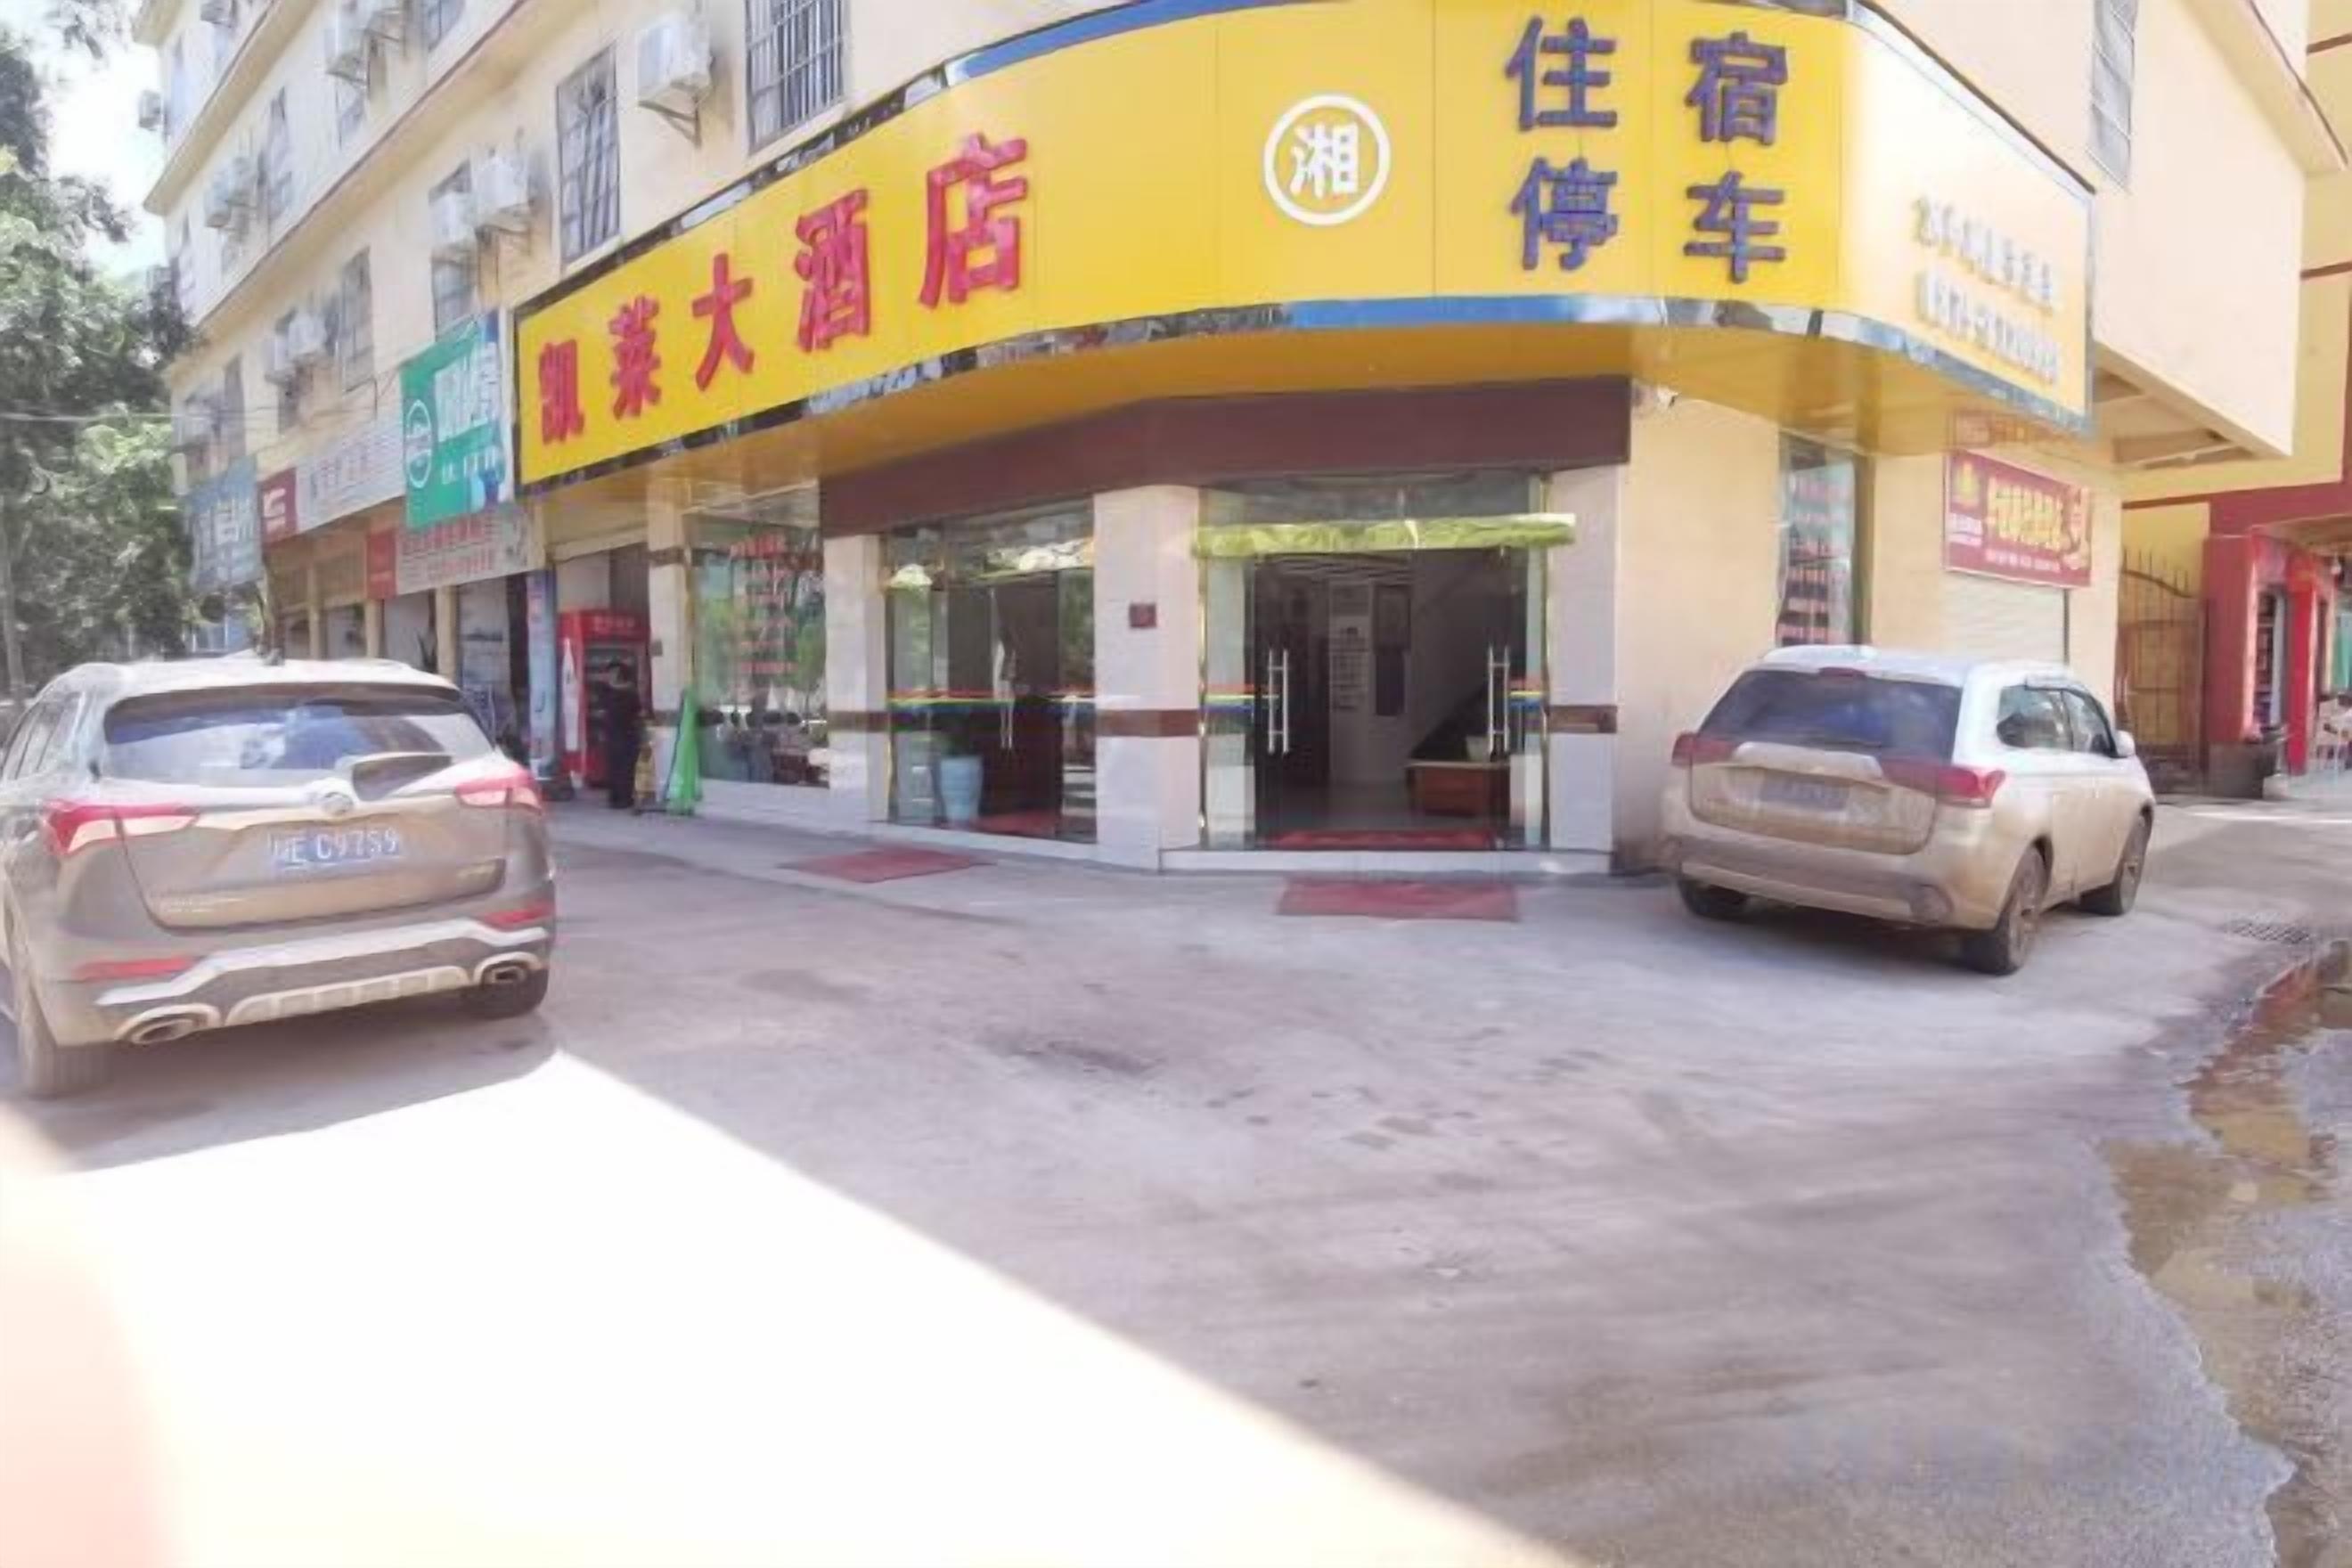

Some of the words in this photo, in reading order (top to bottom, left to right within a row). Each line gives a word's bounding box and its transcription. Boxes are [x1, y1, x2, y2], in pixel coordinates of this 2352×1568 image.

[1505, 16, 1789, 145] 住宿
[1289, 121, 1360, 199] 湘
[1506, 156, 1787, 284] 停车
[537, 133, 1028, 445] 凯莱大酒店
